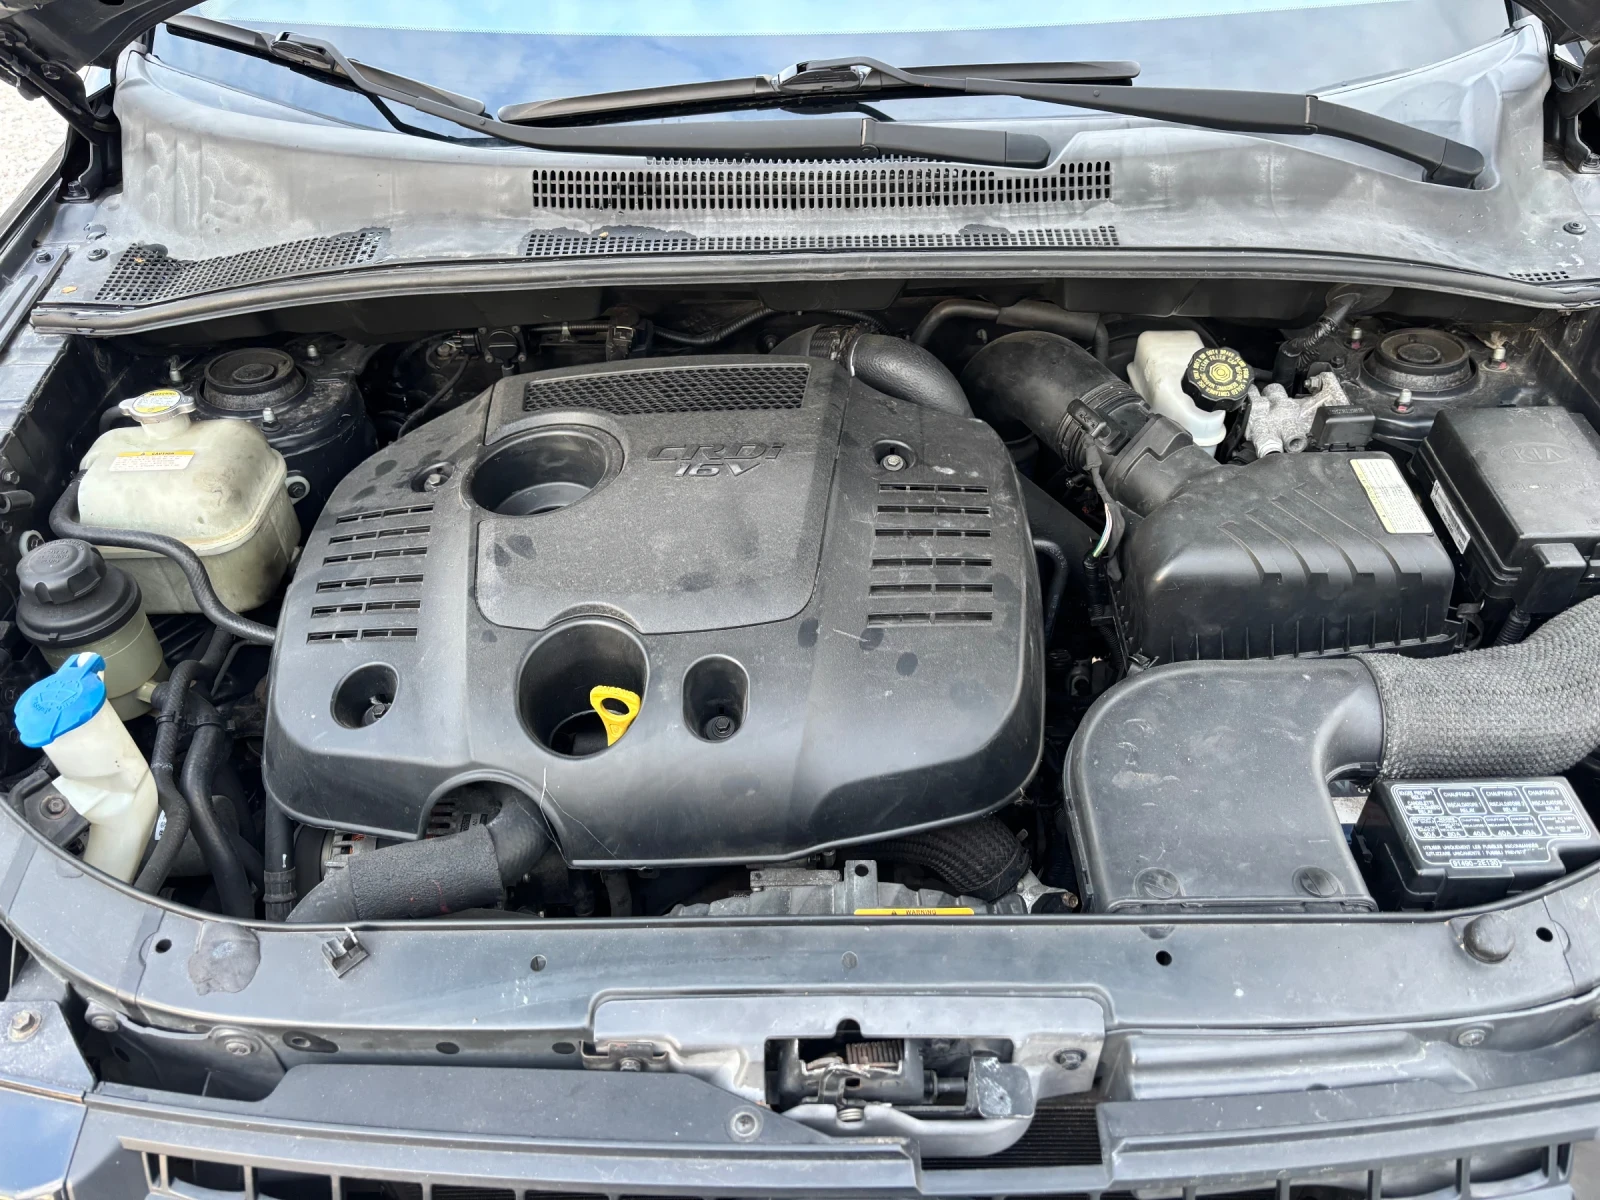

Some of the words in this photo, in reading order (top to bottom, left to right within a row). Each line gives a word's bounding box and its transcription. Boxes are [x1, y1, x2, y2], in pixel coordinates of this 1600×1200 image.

[647, 442, 786, 461] CRDi
[1512, 447, 1563, 460] KIA
[674, 462, 761, 478] 16V
